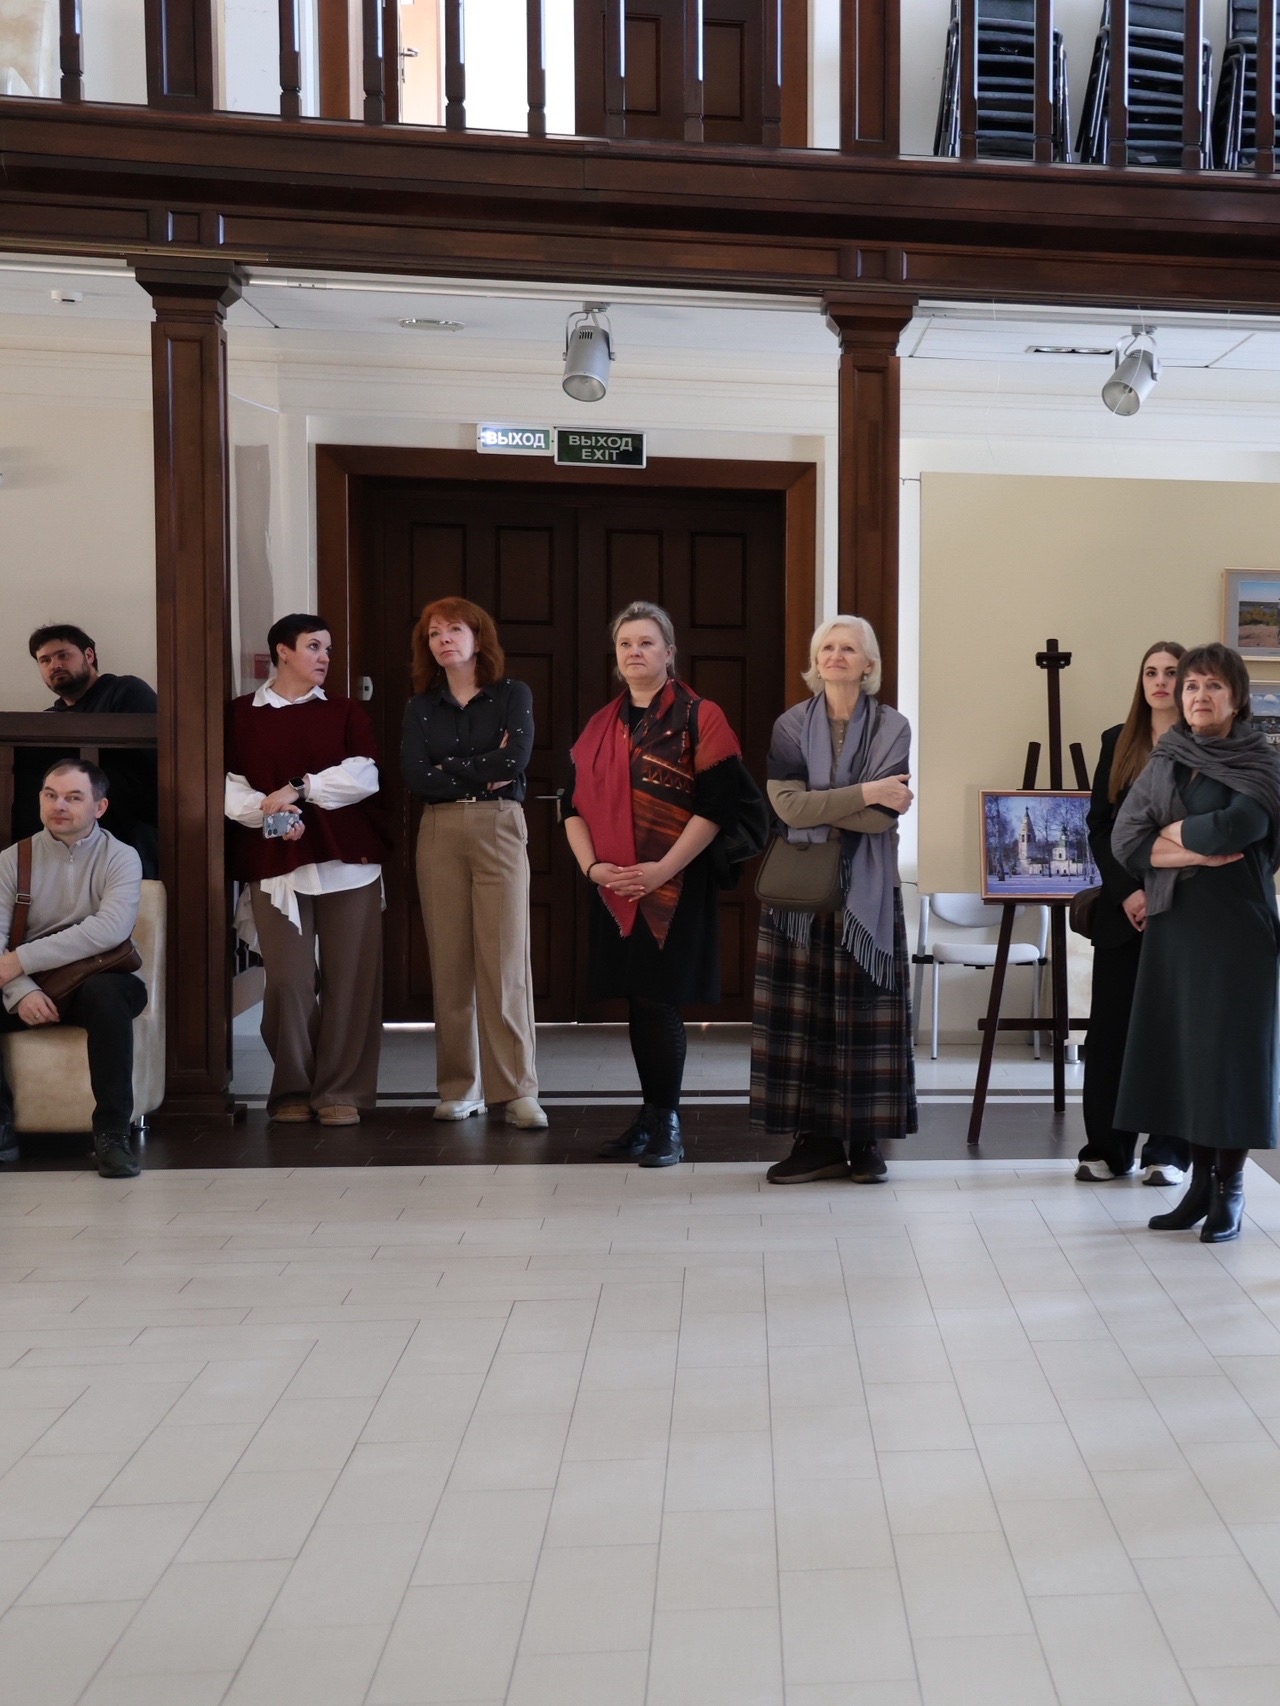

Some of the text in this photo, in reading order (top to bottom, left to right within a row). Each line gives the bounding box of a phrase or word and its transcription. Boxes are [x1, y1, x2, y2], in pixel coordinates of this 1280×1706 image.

[486, 431, 546, 449] ВЫХОД
[568, 435, 633, 452] ВЫХОД
[581, 448, 620, 461] EXIT
